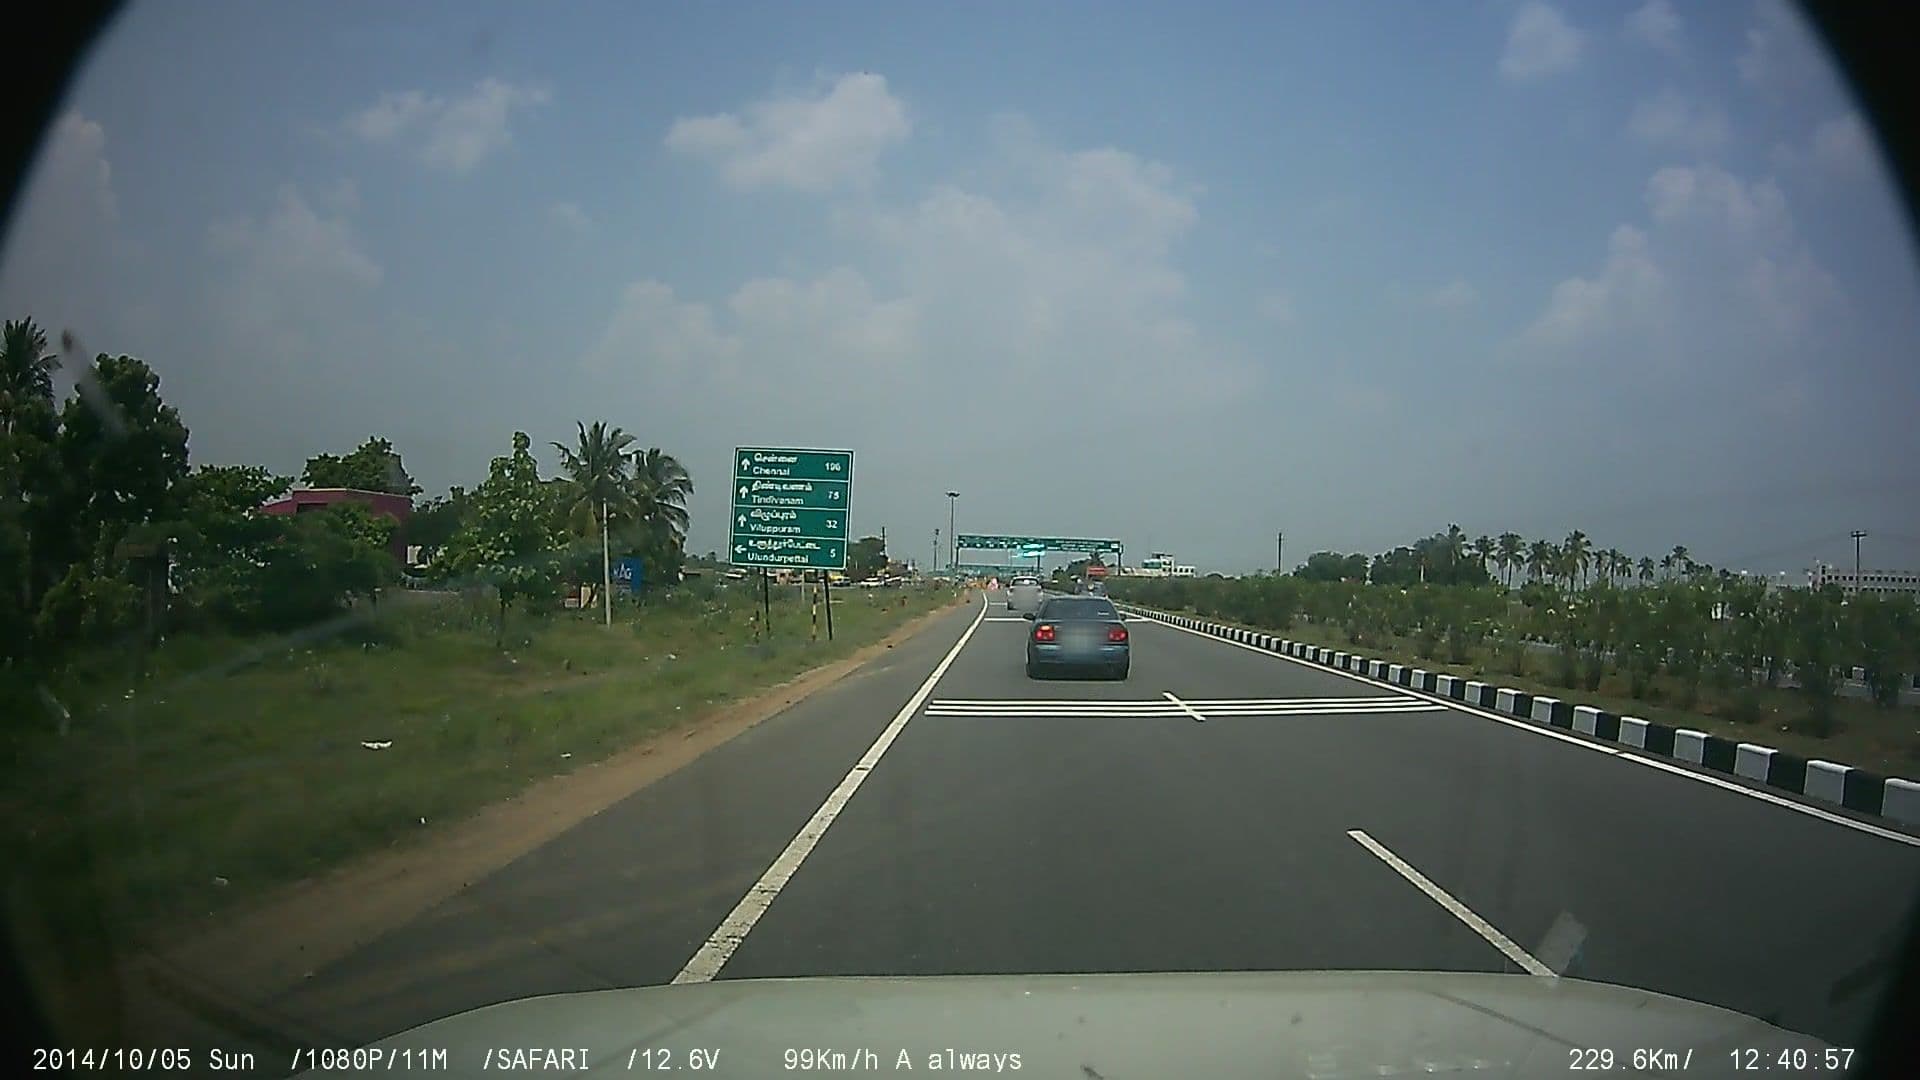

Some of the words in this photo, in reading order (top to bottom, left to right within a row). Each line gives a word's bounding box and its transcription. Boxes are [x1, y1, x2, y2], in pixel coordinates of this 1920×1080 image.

[752, 466, 790, 476] Chennai
[751, 495, 804, 505] Tindivanam
[749, 523, 801, 534] Viluppuram
[825, 520, 838, 529] 32
[830, 548, 837, 558] 5
